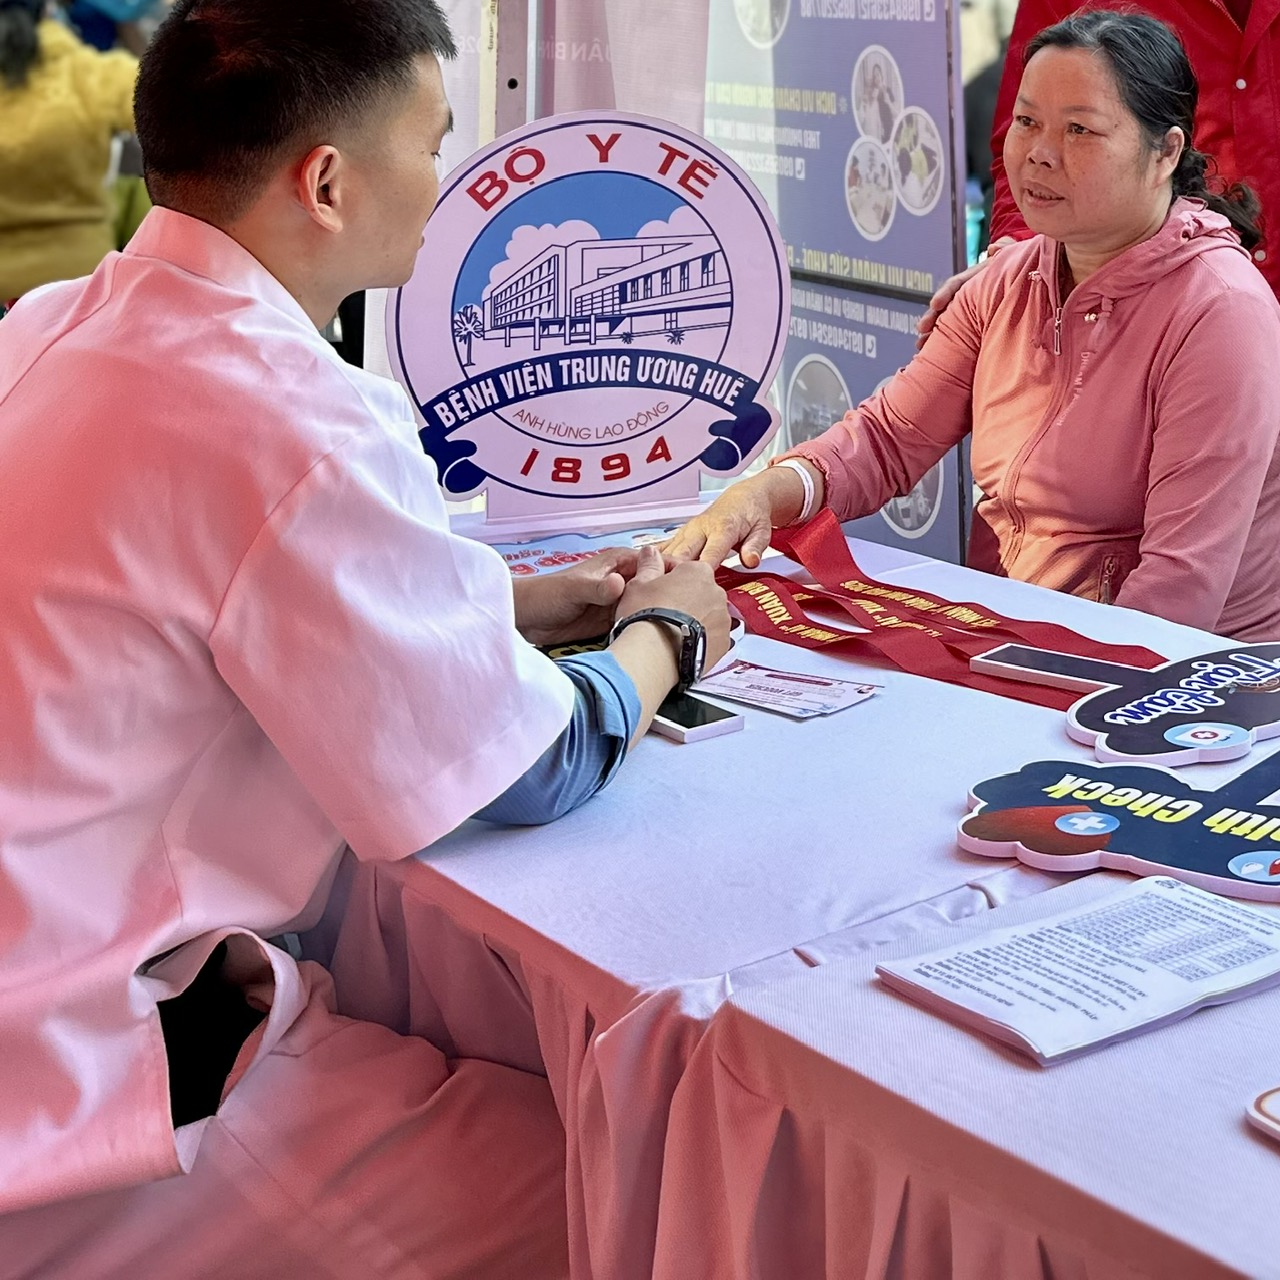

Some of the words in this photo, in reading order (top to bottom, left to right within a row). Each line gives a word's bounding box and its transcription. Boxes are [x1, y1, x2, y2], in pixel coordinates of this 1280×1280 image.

[465, 145, 547, 212] BỘ
[586, 133, 622, 163] Y
[658, 141, 719, 200] TẾ
[433, 377, 499, 429] BỆNH
[499, 361, 554, 399] VIỆN
[558, 354, 632, 385] TRUNG
[636, 355, 699, 396] ƯƠNG
[699, 367, 750, 408] HUẾ
[512, 408, 544, 436] ANH
[546, 414, 592, 441] HÙNG
[595, 422, 626, 440] LAO
[627, 400, 671, 432] ĐỘNG
[519, 435, 673, 484] 1894
[754, 591, 793, 625] XUÂN
[1040, 772, 1204, 826] Check
